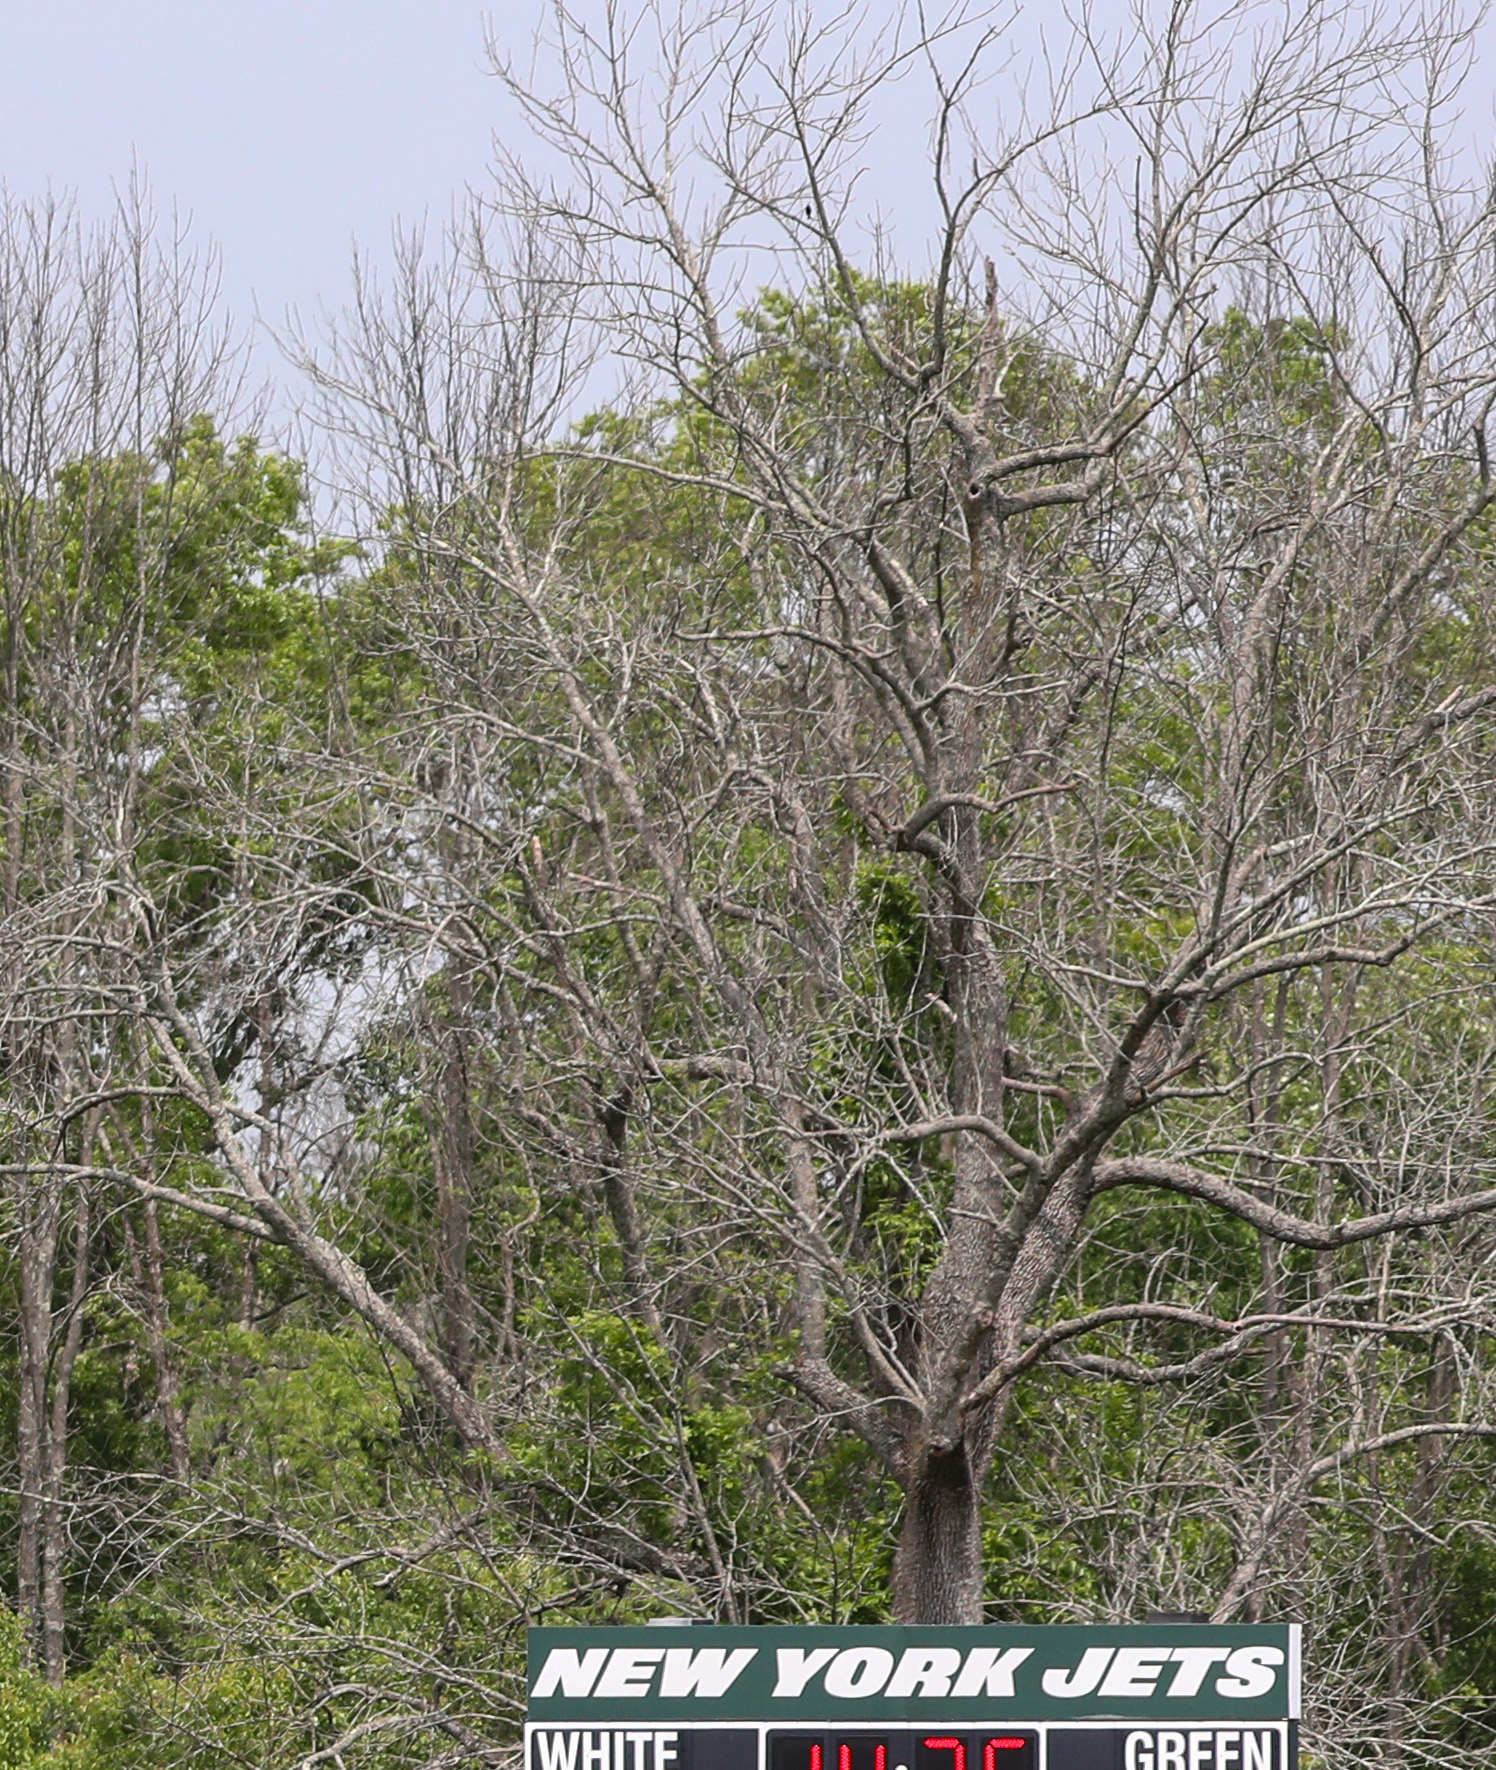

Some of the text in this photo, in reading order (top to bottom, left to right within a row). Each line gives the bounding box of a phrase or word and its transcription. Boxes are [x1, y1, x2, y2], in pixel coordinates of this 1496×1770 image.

[531, 1646, 1286, 1700] NEW YORK JETS
